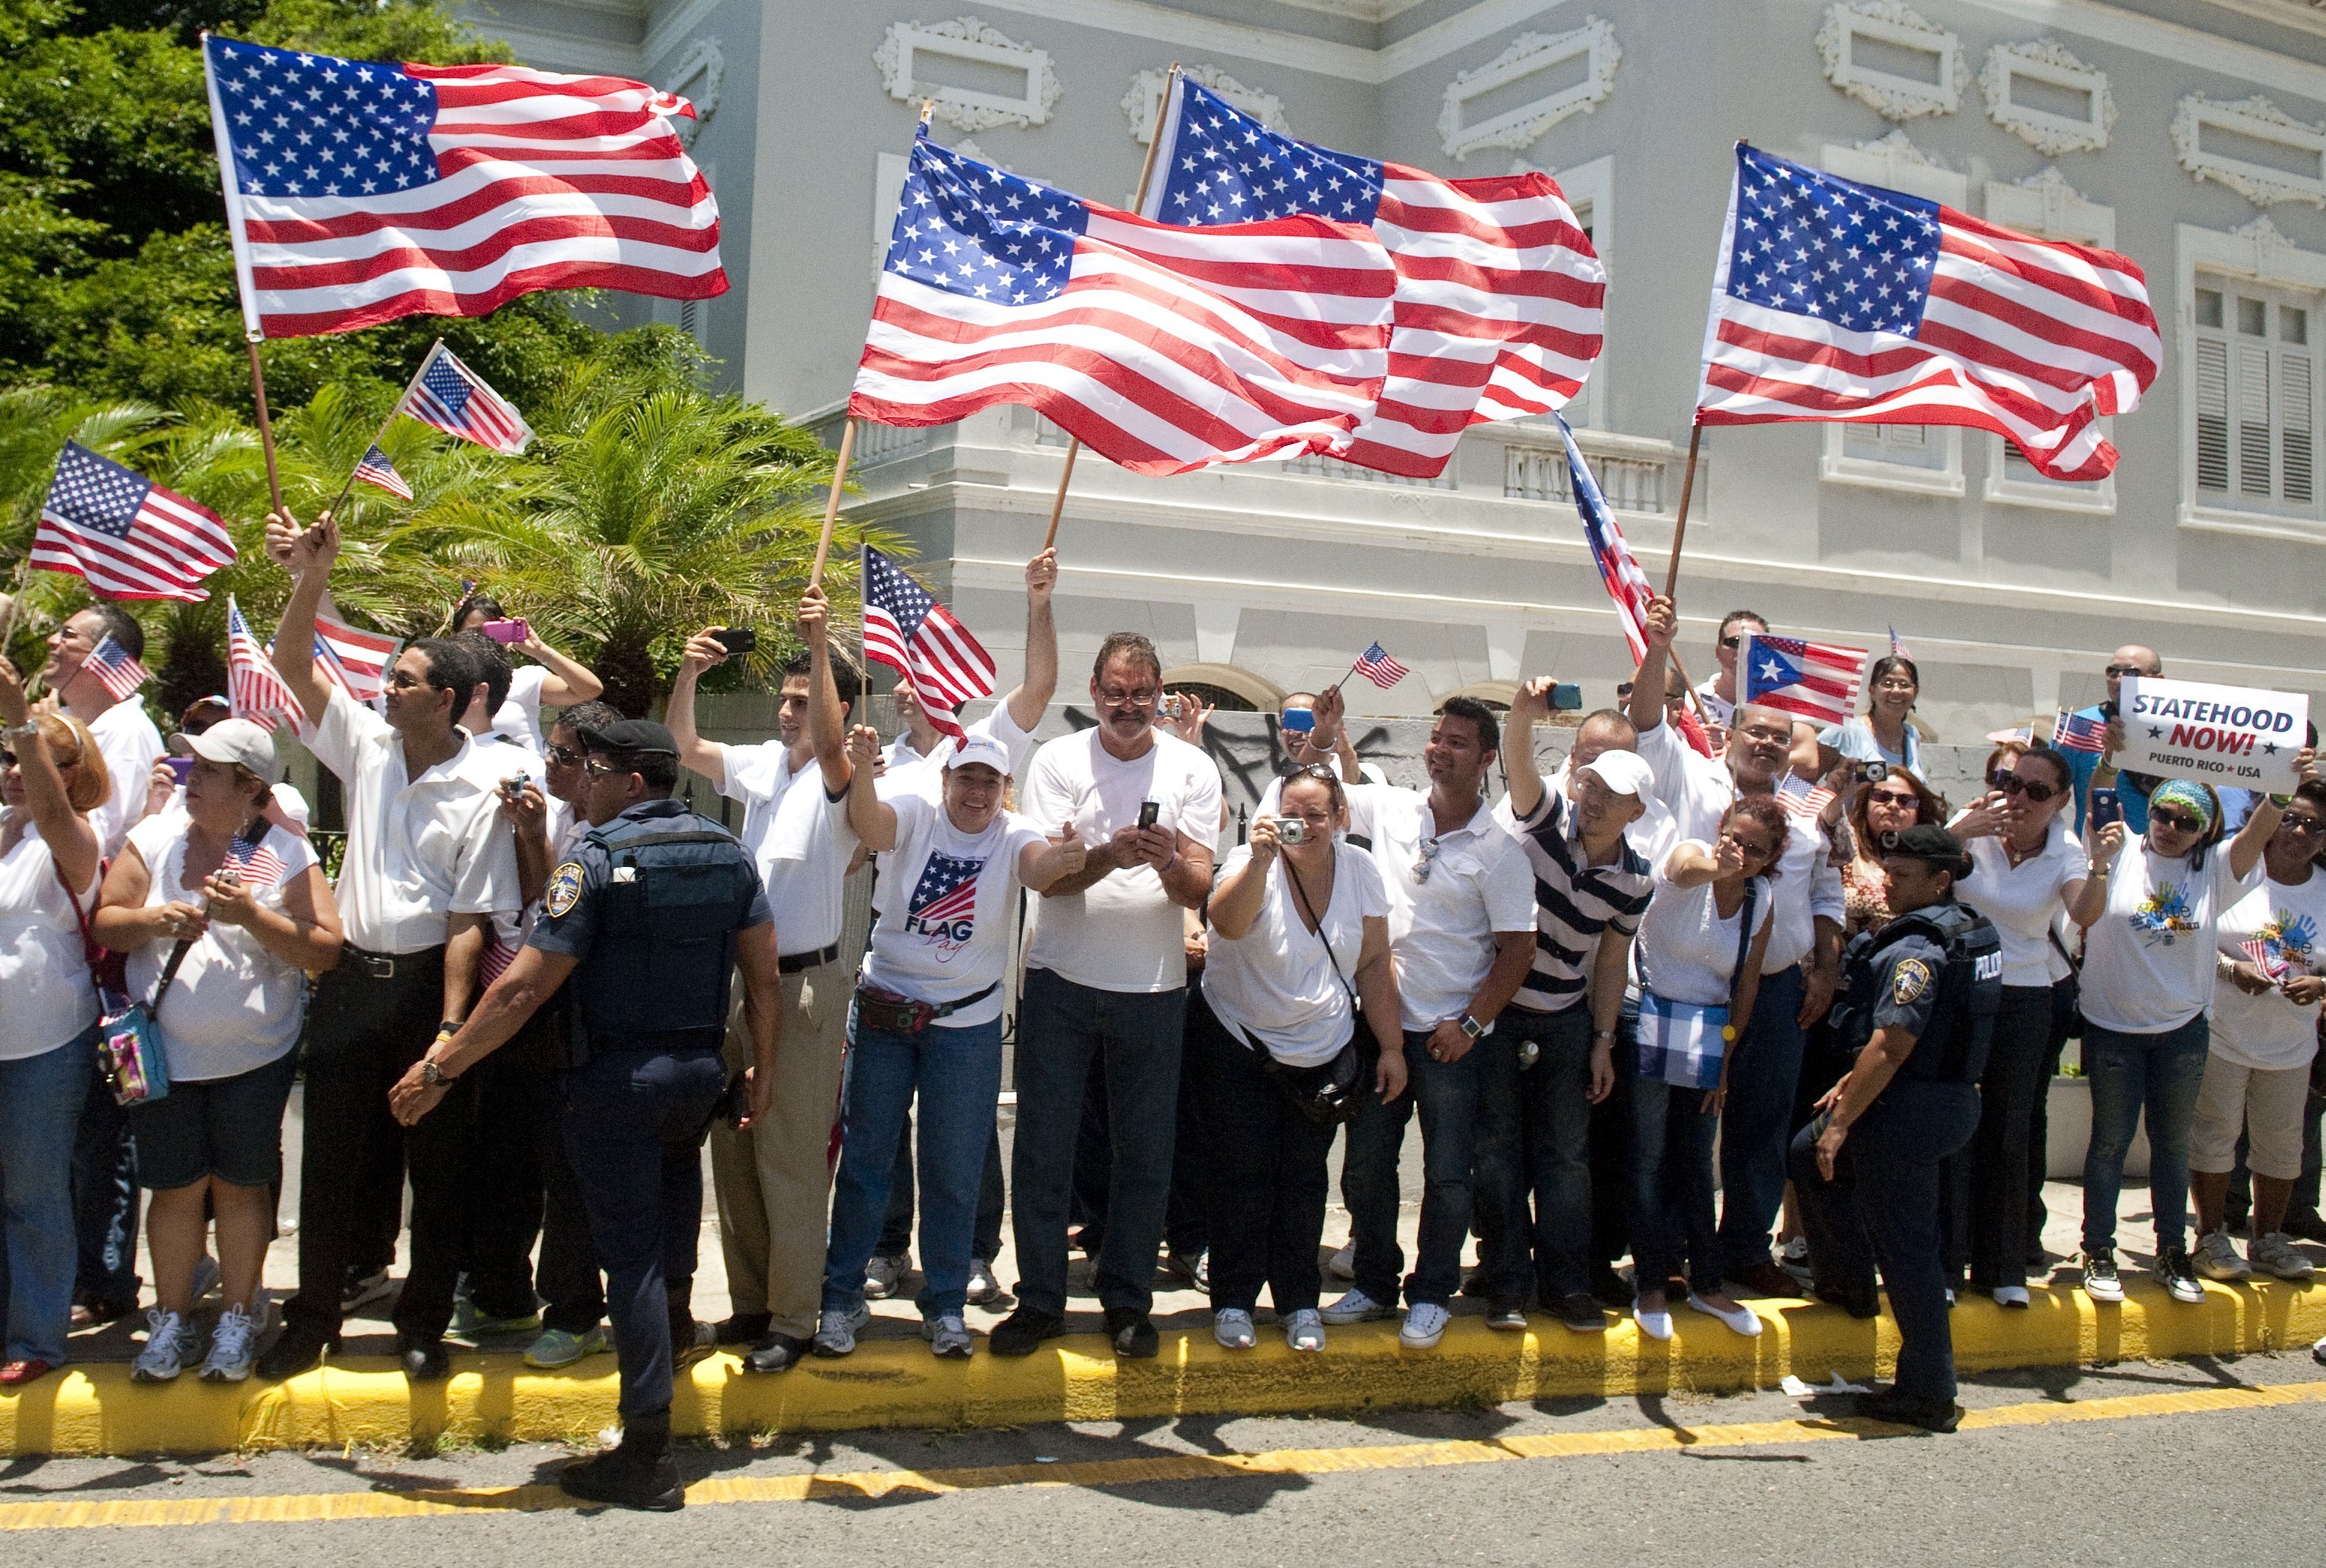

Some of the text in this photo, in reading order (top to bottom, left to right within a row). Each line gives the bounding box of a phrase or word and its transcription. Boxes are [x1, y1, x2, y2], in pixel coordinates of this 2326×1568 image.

[2132, 694, 2293, 733] STATEHOOD
[2168, 724, 2257, 757] NOW!
[2149, 752, 2261, 778] PUERTO RICO USA
[905, 914, 974, 941] FLAG
[2169, 921, 2199, 931] Juan
[923, 928, 972, 963] Day
[2285, 953, 2313, 967] Juan
